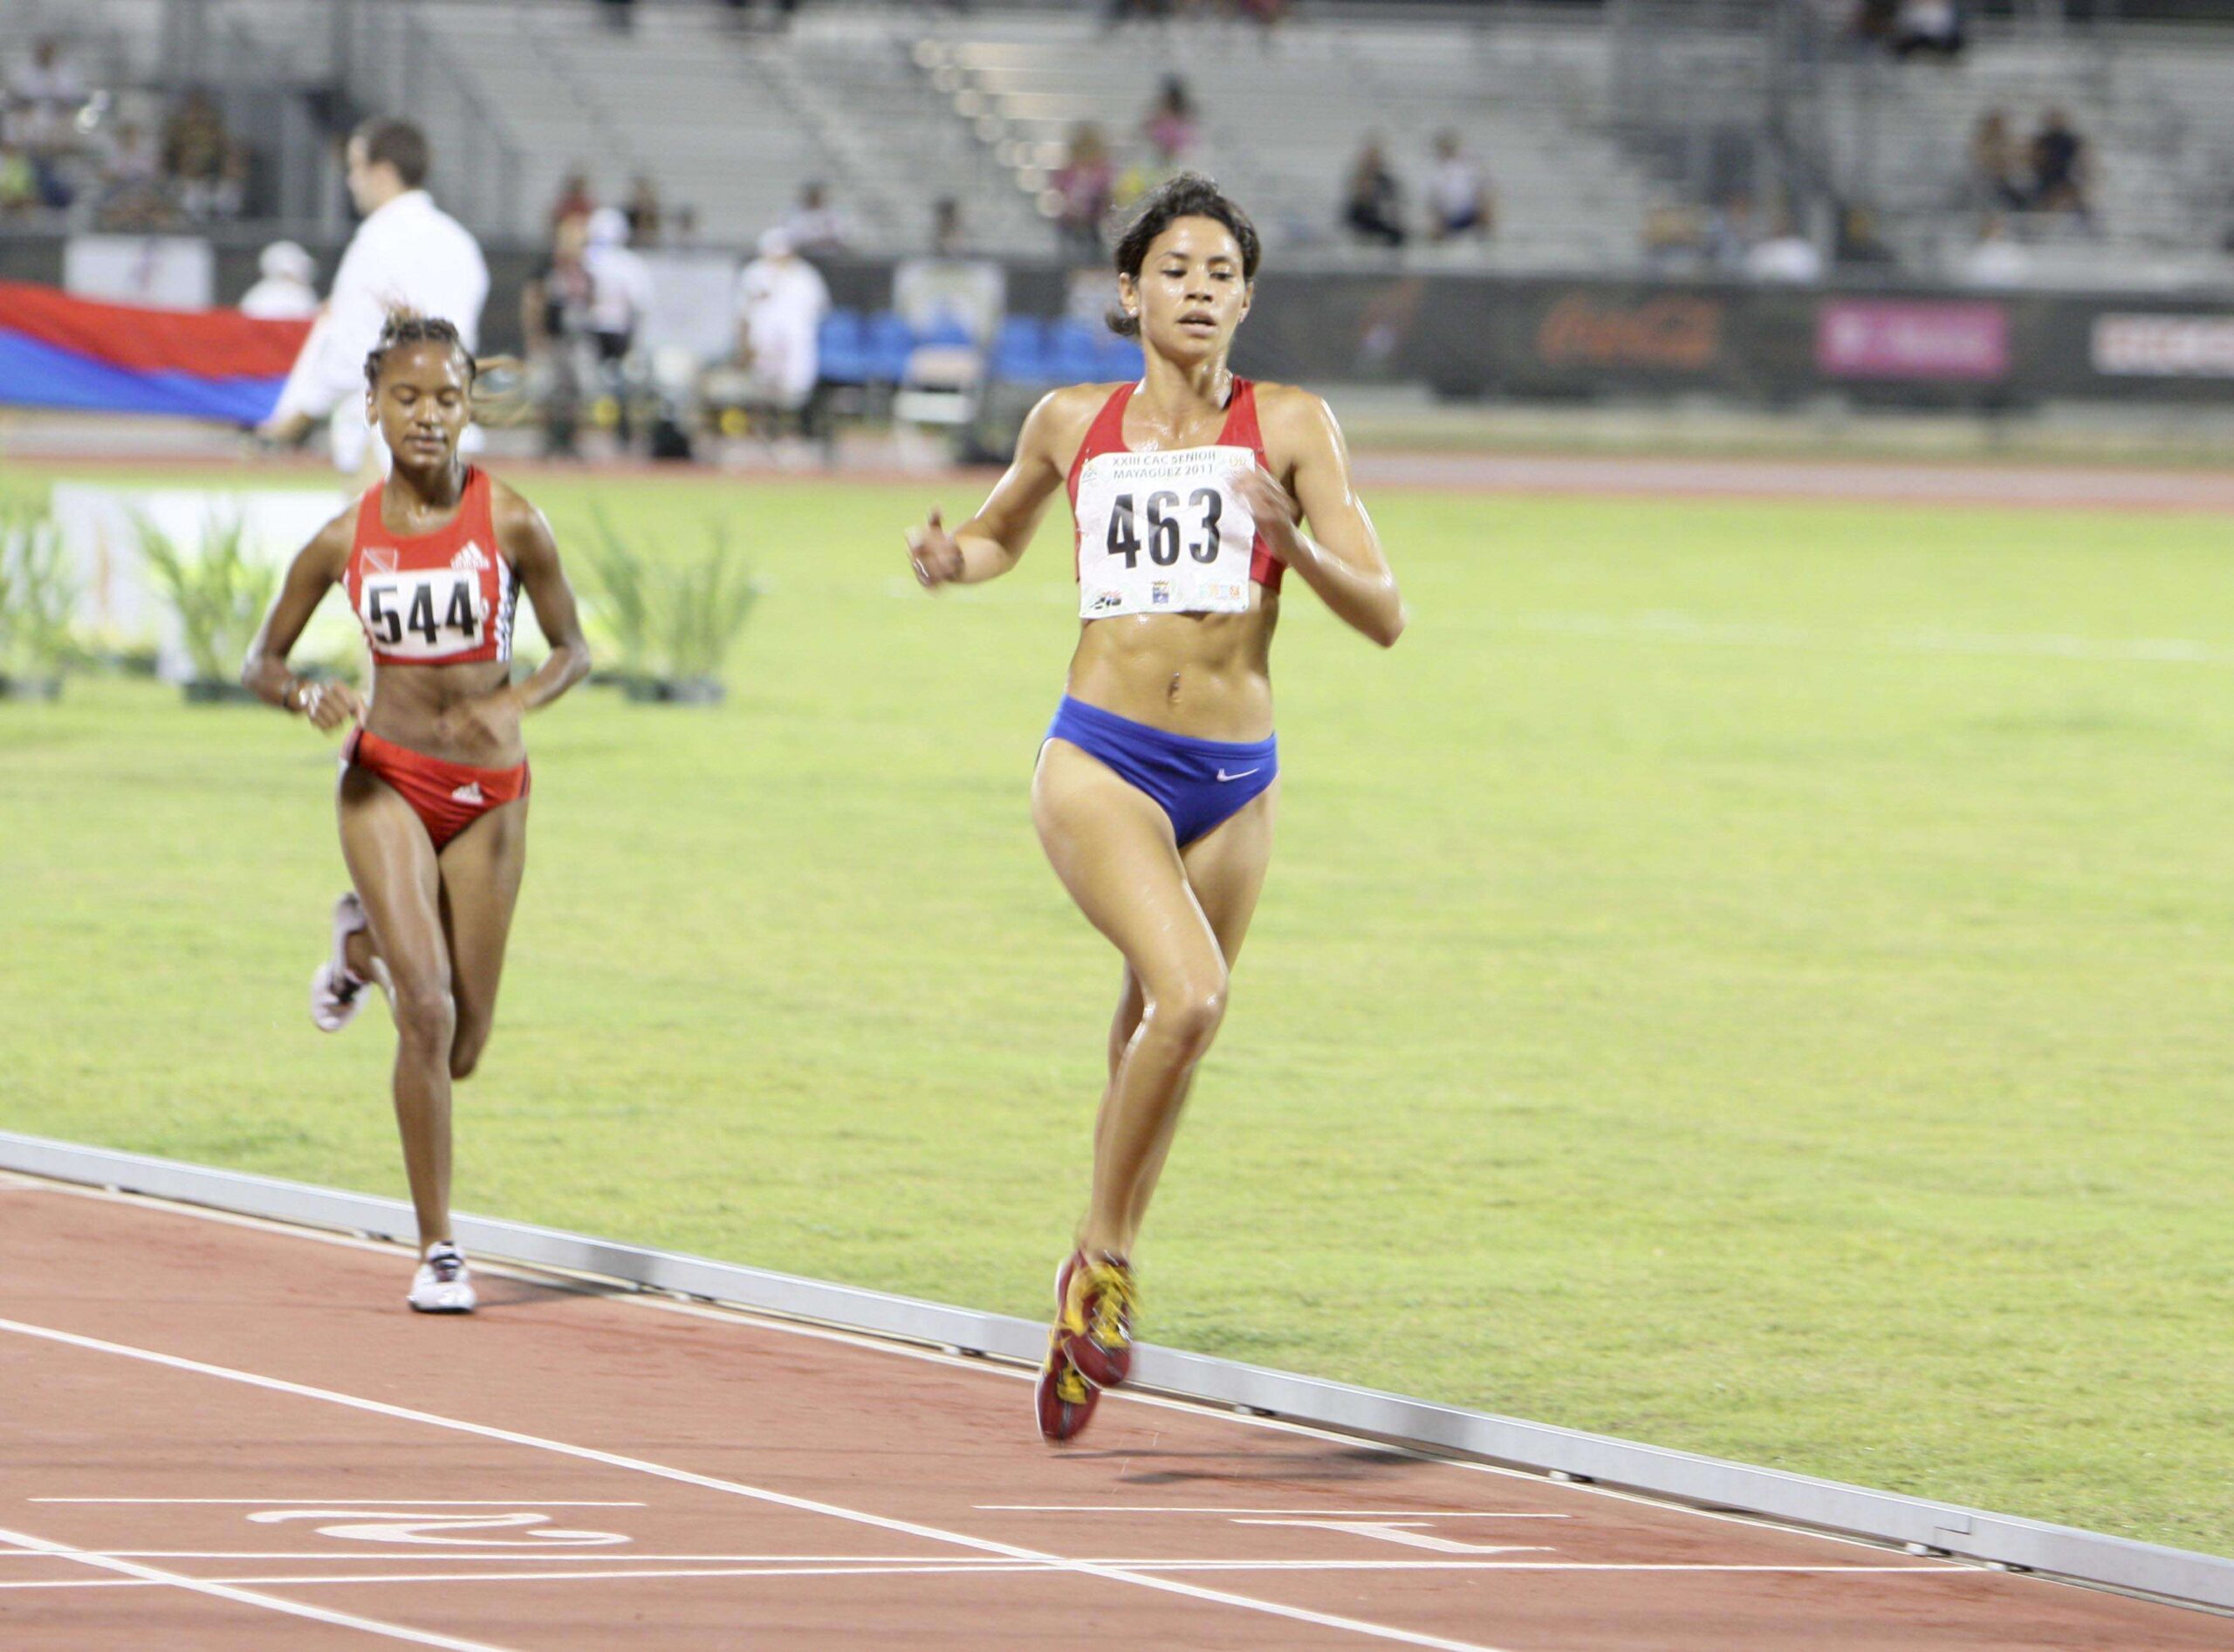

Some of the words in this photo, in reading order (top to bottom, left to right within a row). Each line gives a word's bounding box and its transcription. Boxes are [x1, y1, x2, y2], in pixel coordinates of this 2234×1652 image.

[1113, 456, 1141, 468] XXIII
[1144, 454, 1168, 466] CAC
[1172, 449, 1216, 464] SENIOR
[1185, 463, 1213, 476] 2011
[1107, 487, 1223, 569] 463
[367, 579, 479, 644] 544
